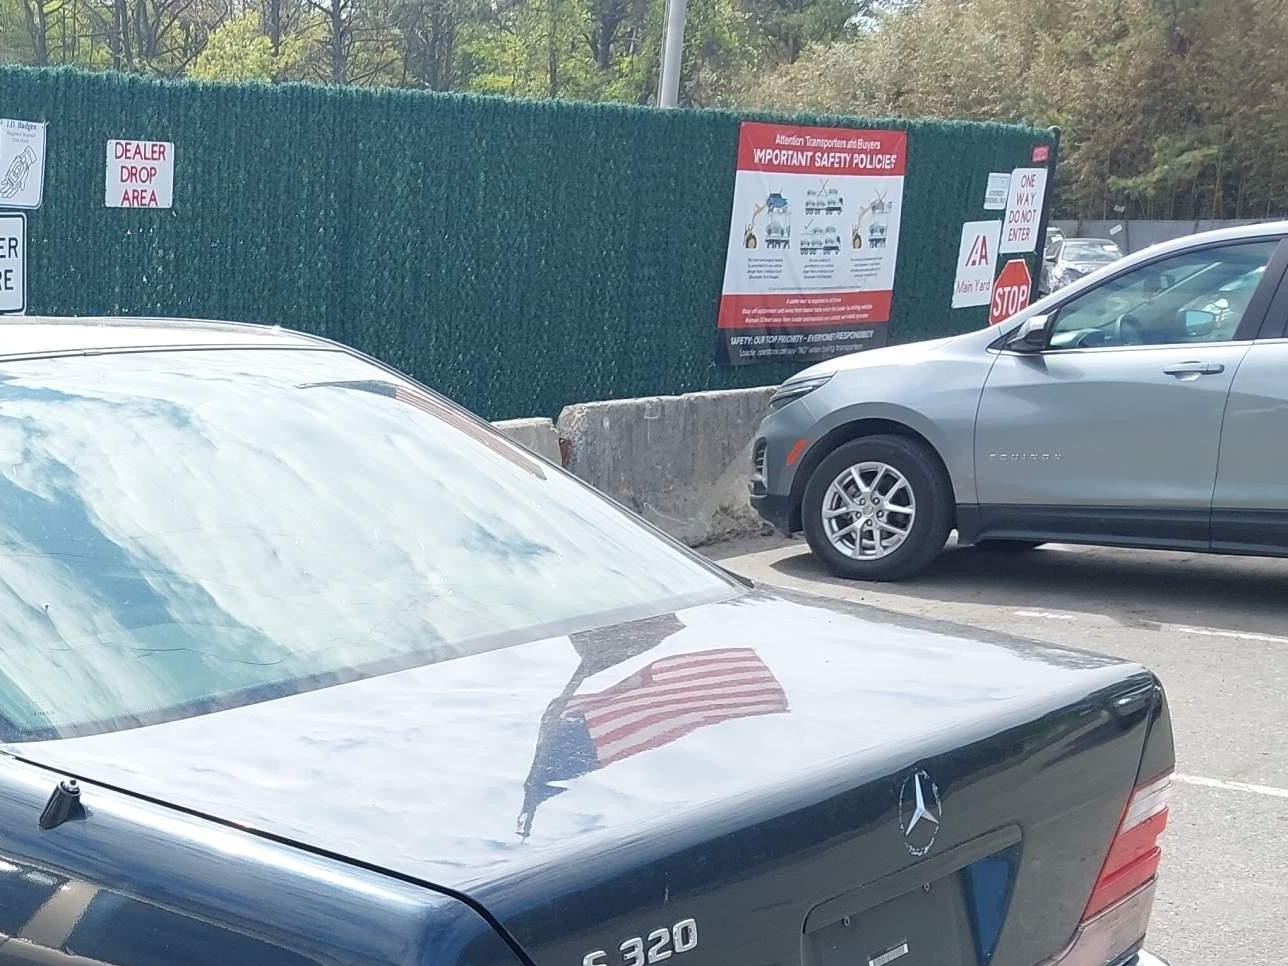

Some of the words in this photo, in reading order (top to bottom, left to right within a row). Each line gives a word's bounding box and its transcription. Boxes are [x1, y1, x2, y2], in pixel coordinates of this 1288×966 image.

[776, 134, 804, 146] Attention
[806, 136, 846, 149] Transporters
[857, 139, 881, 151] Buyers
[114, 142, 166, 161] DEALER
[753, 148, 812, 167] IMPORTANT
[814, 152, 851, 168] SAFETY
[852, 154, 897, 169] POLICIES
[120, 165, 157, 184] DROP
[1020, 174, 1036, 188] ONE
[120, 188, 158, 208] AREA
[1016, 192, 1036, 206] WAY
[1008, 210, 1021, 223] DO
[1022, 209, 1037, 223] NOT
[1008, 227, 1031, 242] ENTER
[957, 280, 973, 294] Main
[975, 280, 991, 292] Yard
[993, 284, 1028, 317] STOP
[765, 335, 777, 344] TOP
[777, 334, 803, 343] PRIORITY
